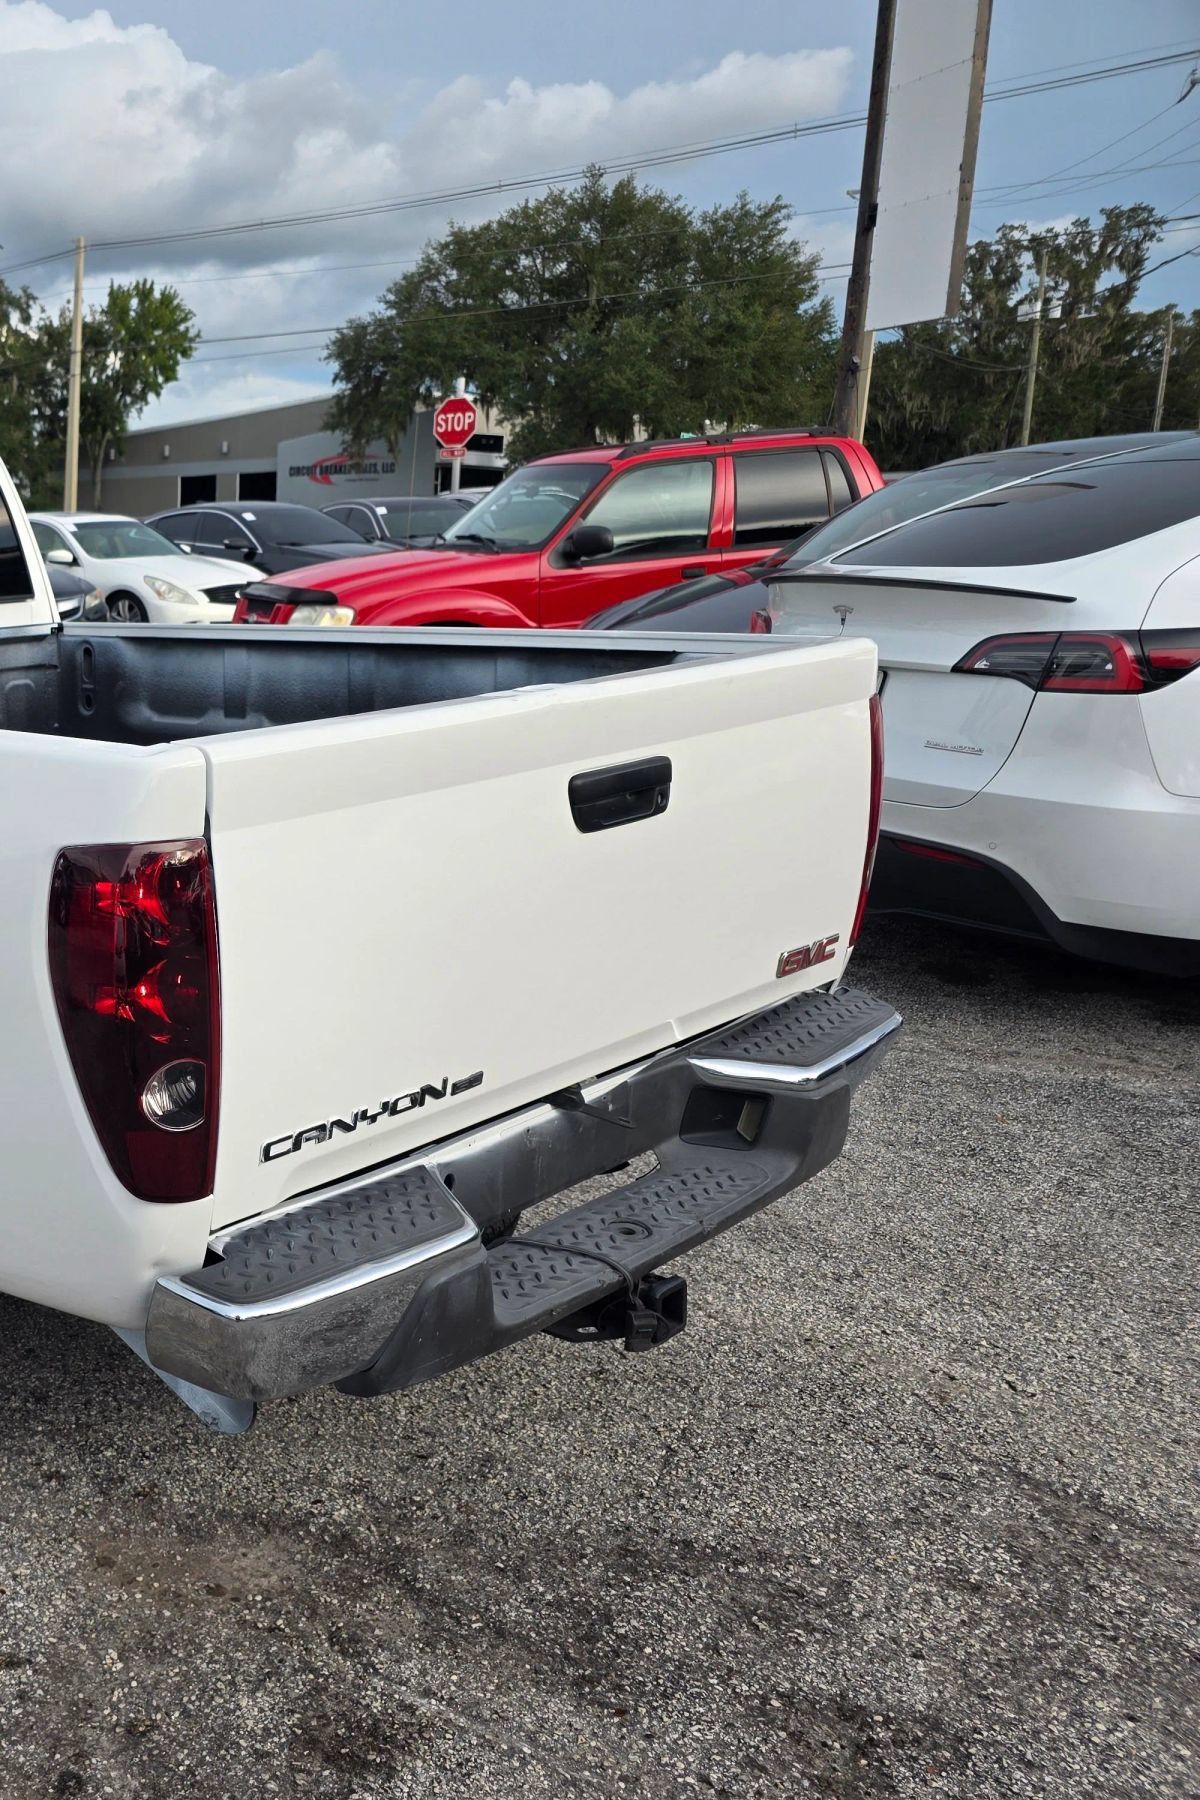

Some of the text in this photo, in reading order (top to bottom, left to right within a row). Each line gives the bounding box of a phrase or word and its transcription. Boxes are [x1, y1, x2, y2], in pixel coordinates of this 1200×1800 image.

[437, 411, 474, 432] STOP
[288, 464, 317, 477] CIRCUIT
[381, 461, 396, 474] LLC
[776, 932, 840, 978] GMC
[258, 1076, 449, 1165] CANYON
